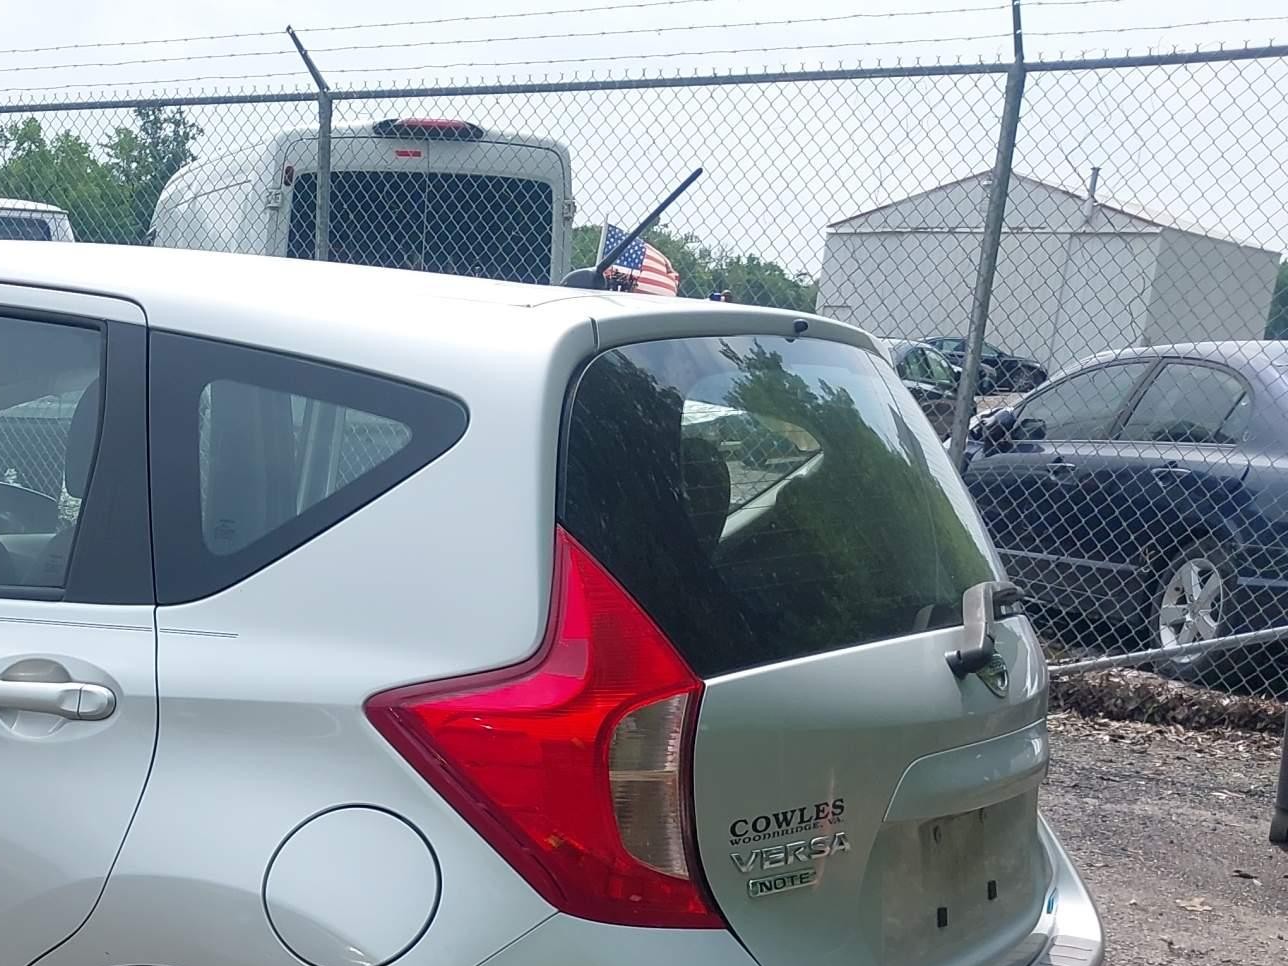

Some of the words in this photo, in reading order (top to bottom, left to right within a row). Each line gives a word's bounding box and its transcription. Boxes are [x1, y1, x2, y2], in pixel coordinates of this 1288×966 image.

[730, 798, 845, 838] COWLES
[730, 832, 851, 873] VERSA
[759, 872, 811, 893] NOTE
